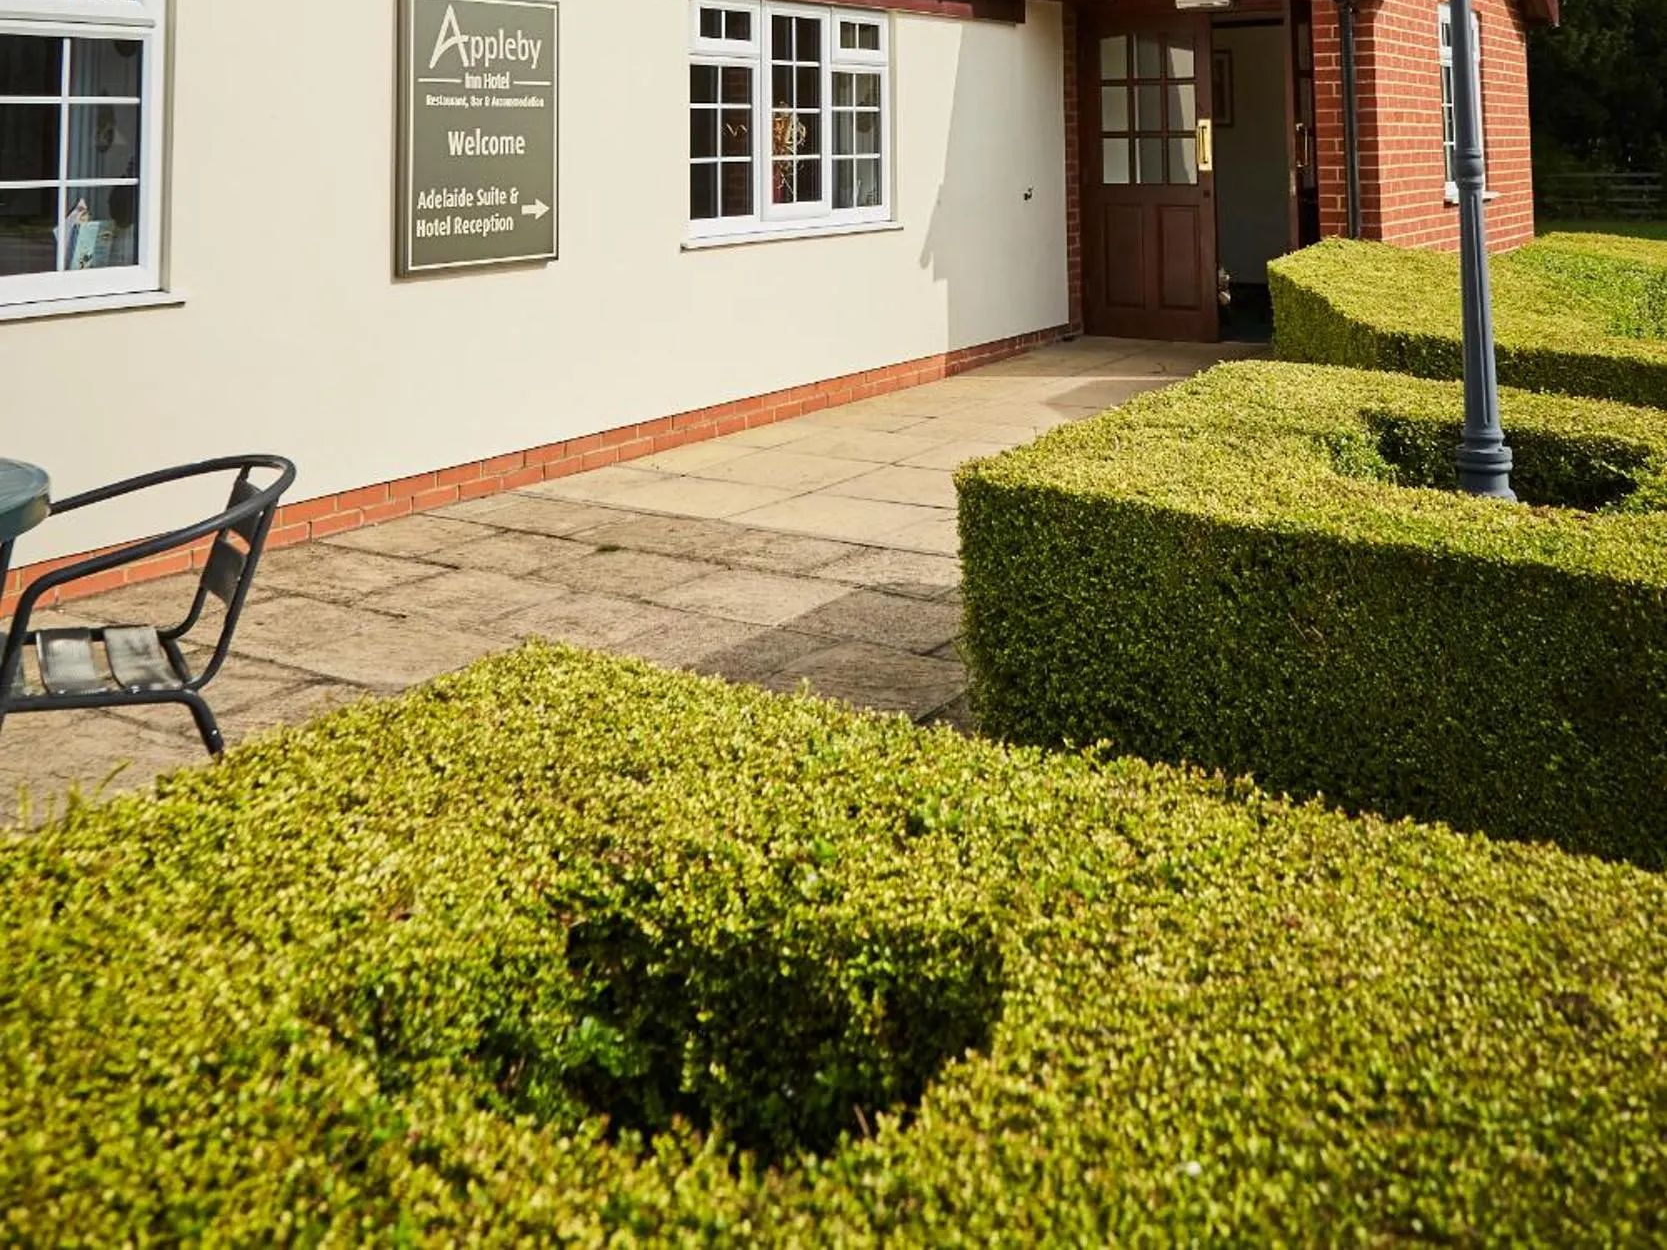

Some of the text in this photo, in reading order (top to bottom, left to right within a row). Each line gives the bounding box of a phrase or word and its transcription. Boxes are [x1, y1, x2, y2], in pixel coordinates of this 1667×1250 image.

[429, 4, 542, 69] Appleby
[464, 71, 511, 89] Inn Hotel
[426, 94, 545, 108] Restaurant, Bar & Accommodation
[448, 128, 526, 156] Welcome
[417, 187, 519, 210] Adelaide Suite &
[416, 213, 514, 238] Hotel Reception
